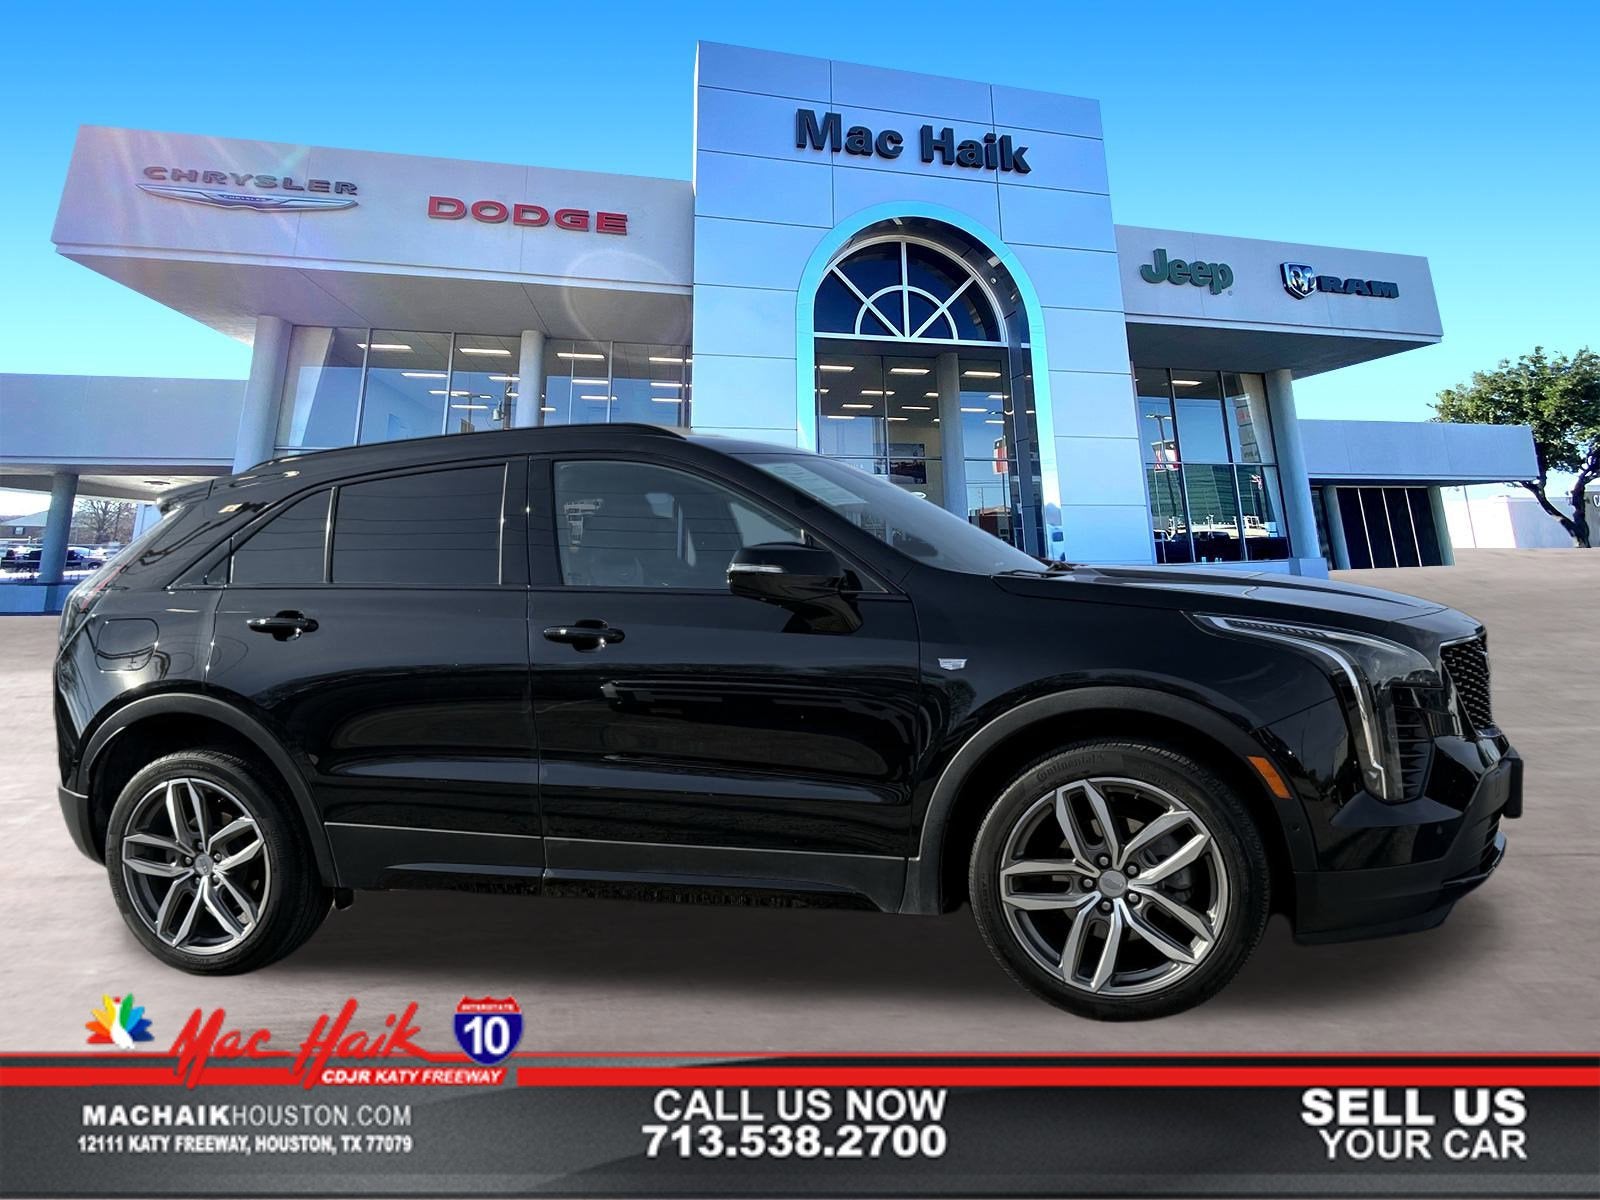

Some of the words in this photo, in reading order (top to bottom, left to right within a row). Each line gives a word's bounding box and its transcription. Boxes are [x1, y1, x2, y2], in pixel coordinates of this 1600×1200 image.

[796, 107, 903, 160] Mac
[919, 124, 1032, 175] Haik
[143, 165, 358, 196] CHRYSLER
[428, 196, 628, 235] DODGE
[1140, 248, 1234, 295] Jeep
[1316, 275, 1399, 299] RAM
